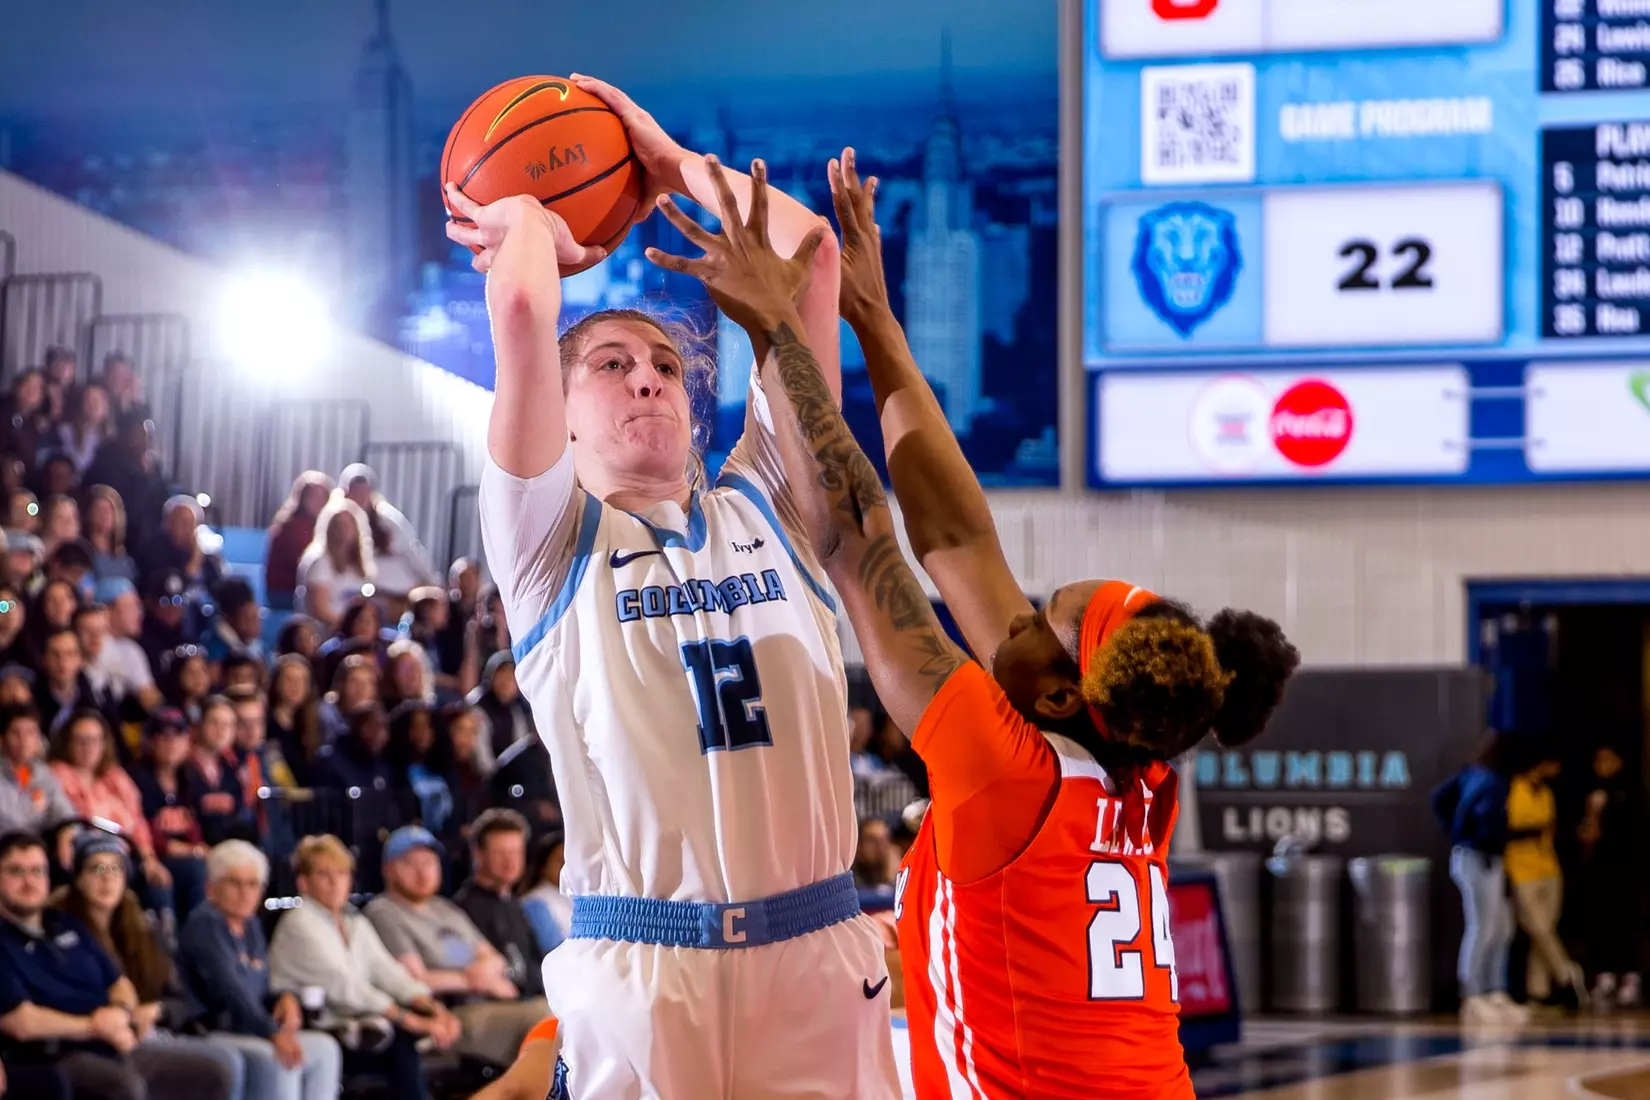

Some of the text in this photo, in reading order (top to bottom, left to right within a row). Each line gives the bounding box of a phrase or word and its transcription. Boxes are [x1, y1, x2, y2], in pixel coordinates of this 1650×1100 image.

[1337, 238, 1434, 291] 22
[731, 541, 753, 554] Ivy
[615, 568, 788, 623] COLUMBIA
[680, 634, 774, 756] 12
[1195, 750, 1411, 788] OLUMBIA
[1222, 805, 1351, 843] LIONS
[722, 907, 747, 943] C
[1084, 859, 1178, 1003] 24
